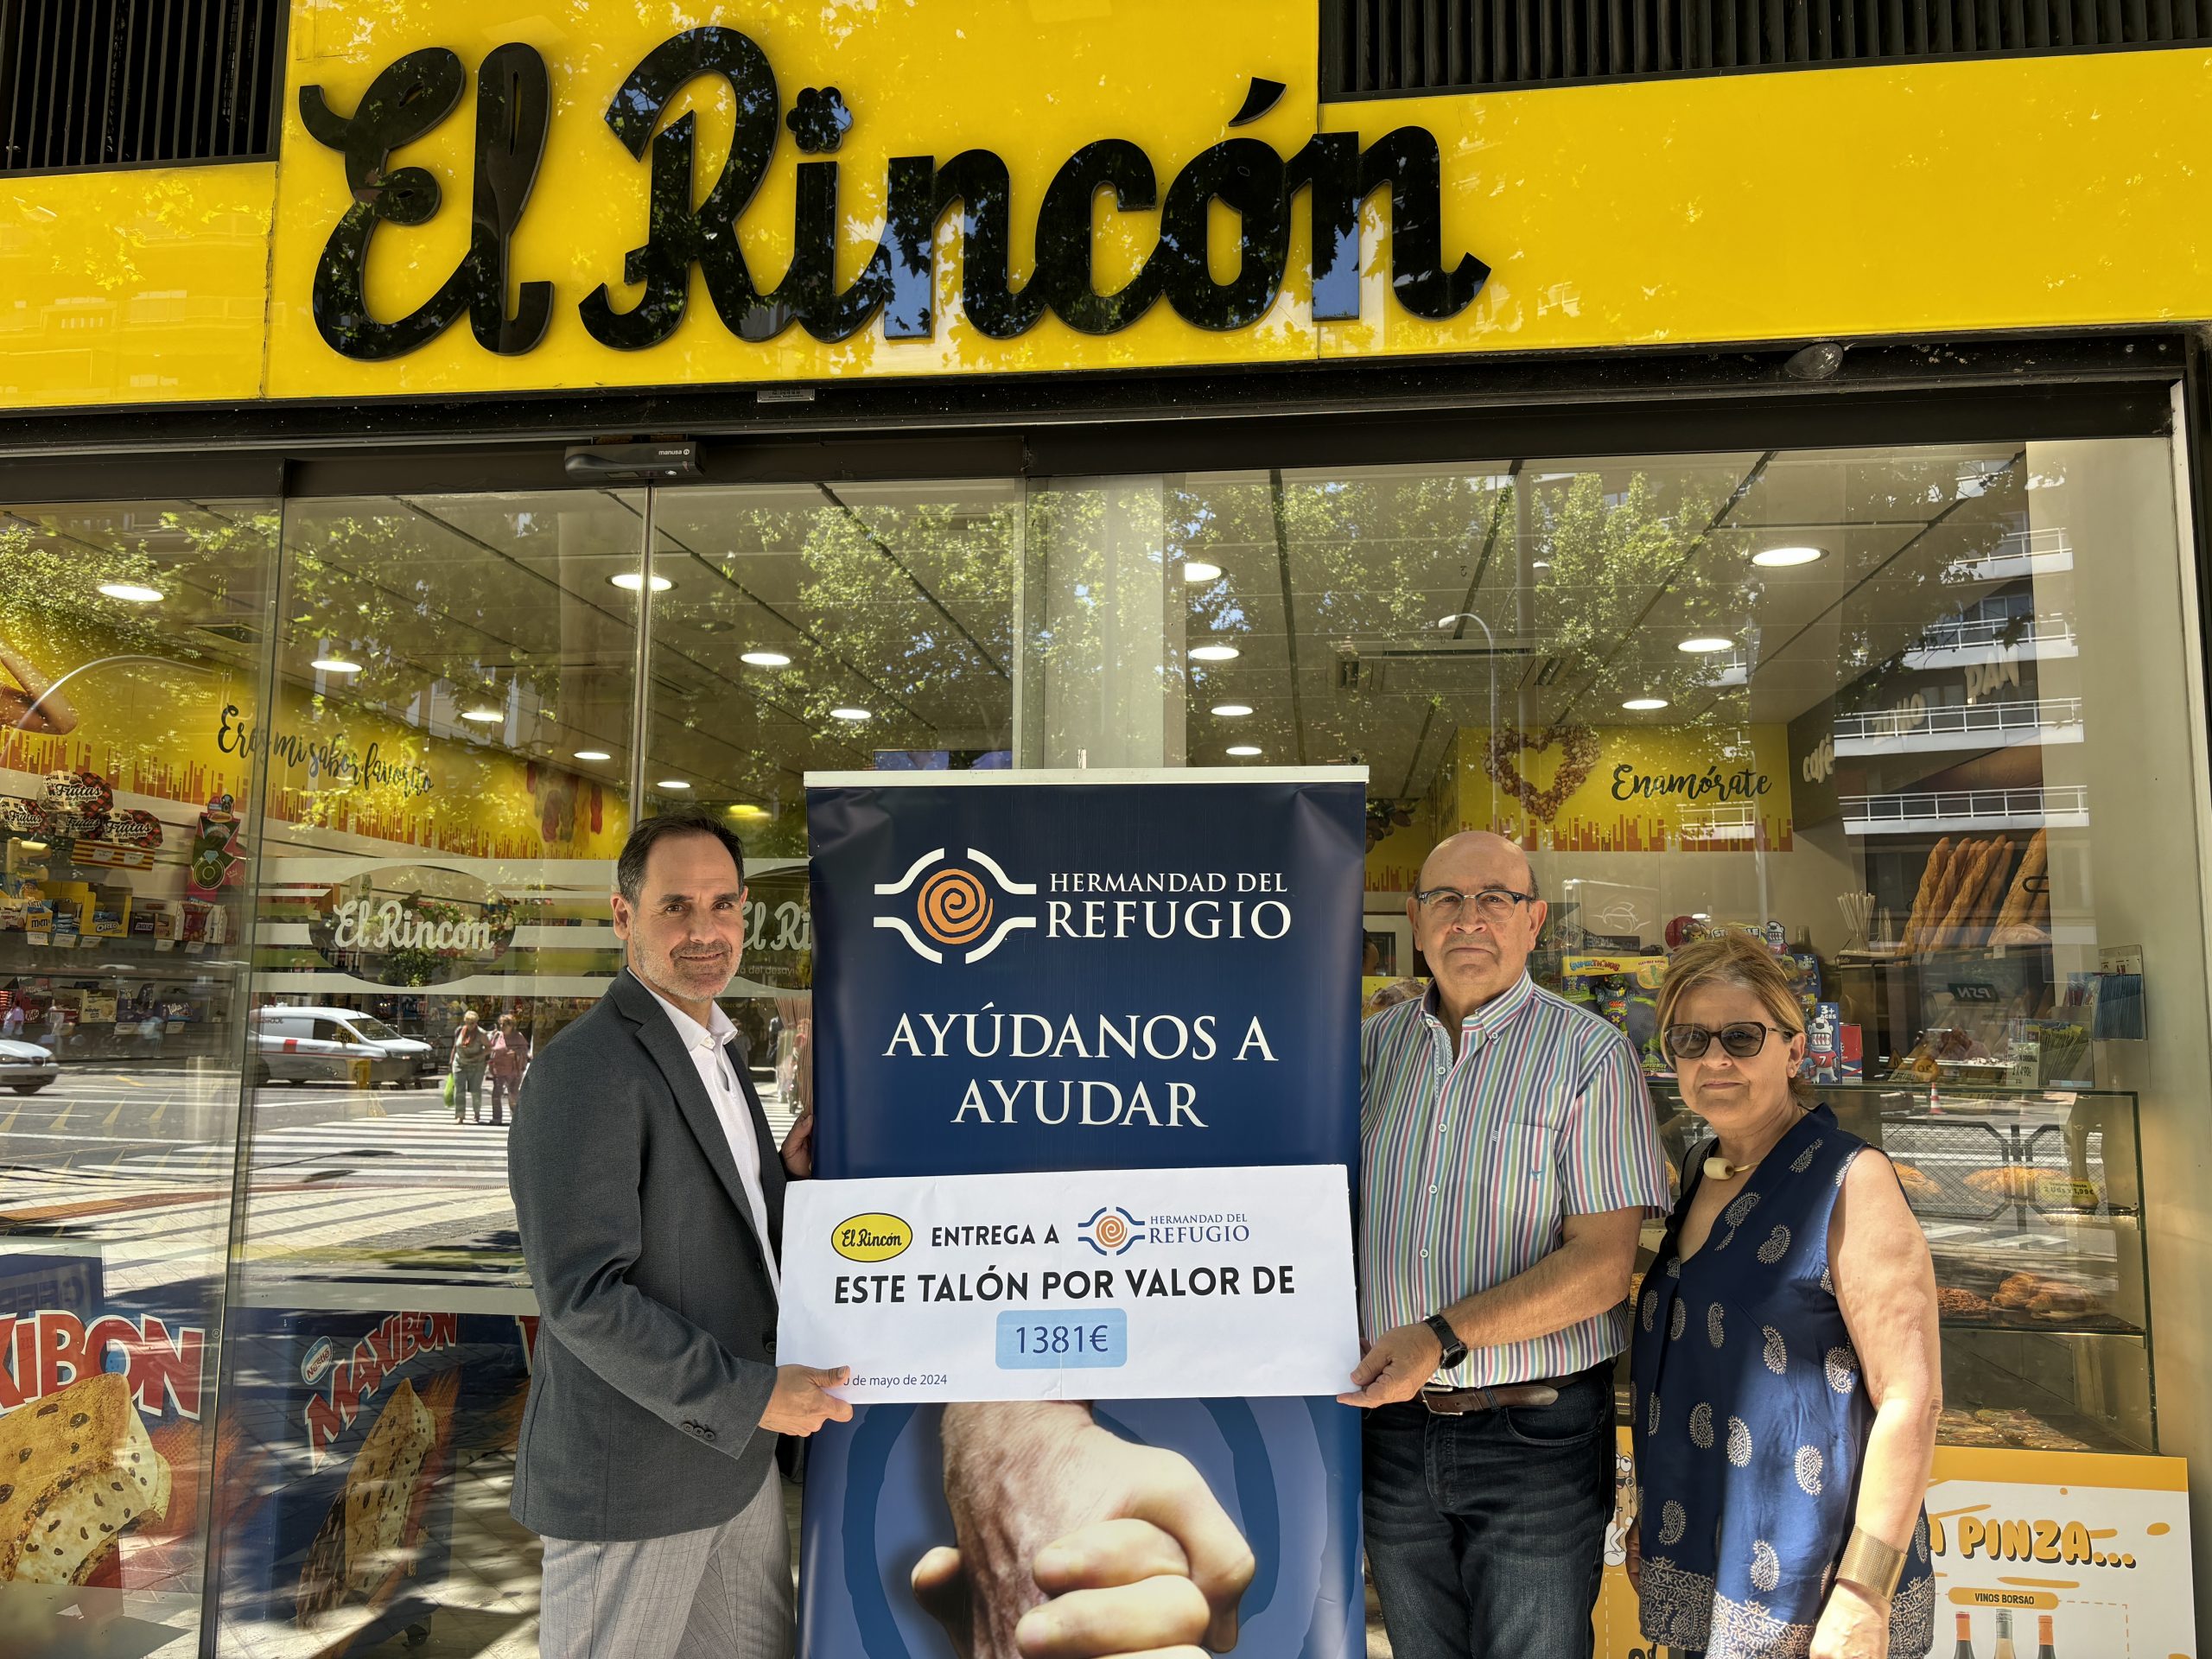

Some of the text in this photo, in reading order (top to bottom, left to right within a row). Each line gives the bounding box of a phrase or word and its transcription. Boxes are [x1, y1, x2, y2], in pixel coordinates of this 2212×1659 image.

[299, 25, 1491, 362] El Rincón
[273, 731, 308, 767] mi
[309, 734, 364, 785] sabor
[56, 784, 102, 797] Frutas
[1611, 764, 1772, 801] Enamórate
[10, 811, 42, 823] Frutas
[108, 821, 152, 833] Frutas
[1049, 873, 1287, 893] HERMANDAD DEL
[96, 923, 118, 932] OREO
[334, 900, 371, 948] El
[1046, 900, 1292, 939] REFUGIO
[1821, 1005, 1835, 1014] 3+
[881, 1001, 1279, 1061] AYÚDANOS A
[1818, 1055, 1826, 1065] 7
[950, 1079, 1209, 1128] AYUDAR
[1150, 1213, 1247, 1224] HERMANDAD DEL
[841, 1228, 902, 1247] El Rincón
[931, 1224, 1059, 1246] ENTREGA A
[1149, 1224, 1249, 1244] REFUGIO
[835, 1265, 1294, 1303] ESTE TALÓN POR VALOR DE
[1016, 1324, 1108, 1355] 1381€
[853, 1375, 867, 1386] de
[869, 1376, 900, 1388] mayo
[903, 1374, 917, 1385] de
[920, 1374, 947, 1385] 2024
[305, 1311, 457, 1475] MAXIBON
[1958, 1516, 2137, 1568] PINZA...
[1974, 1592, 2034, 1605] VINOS BORSAO
